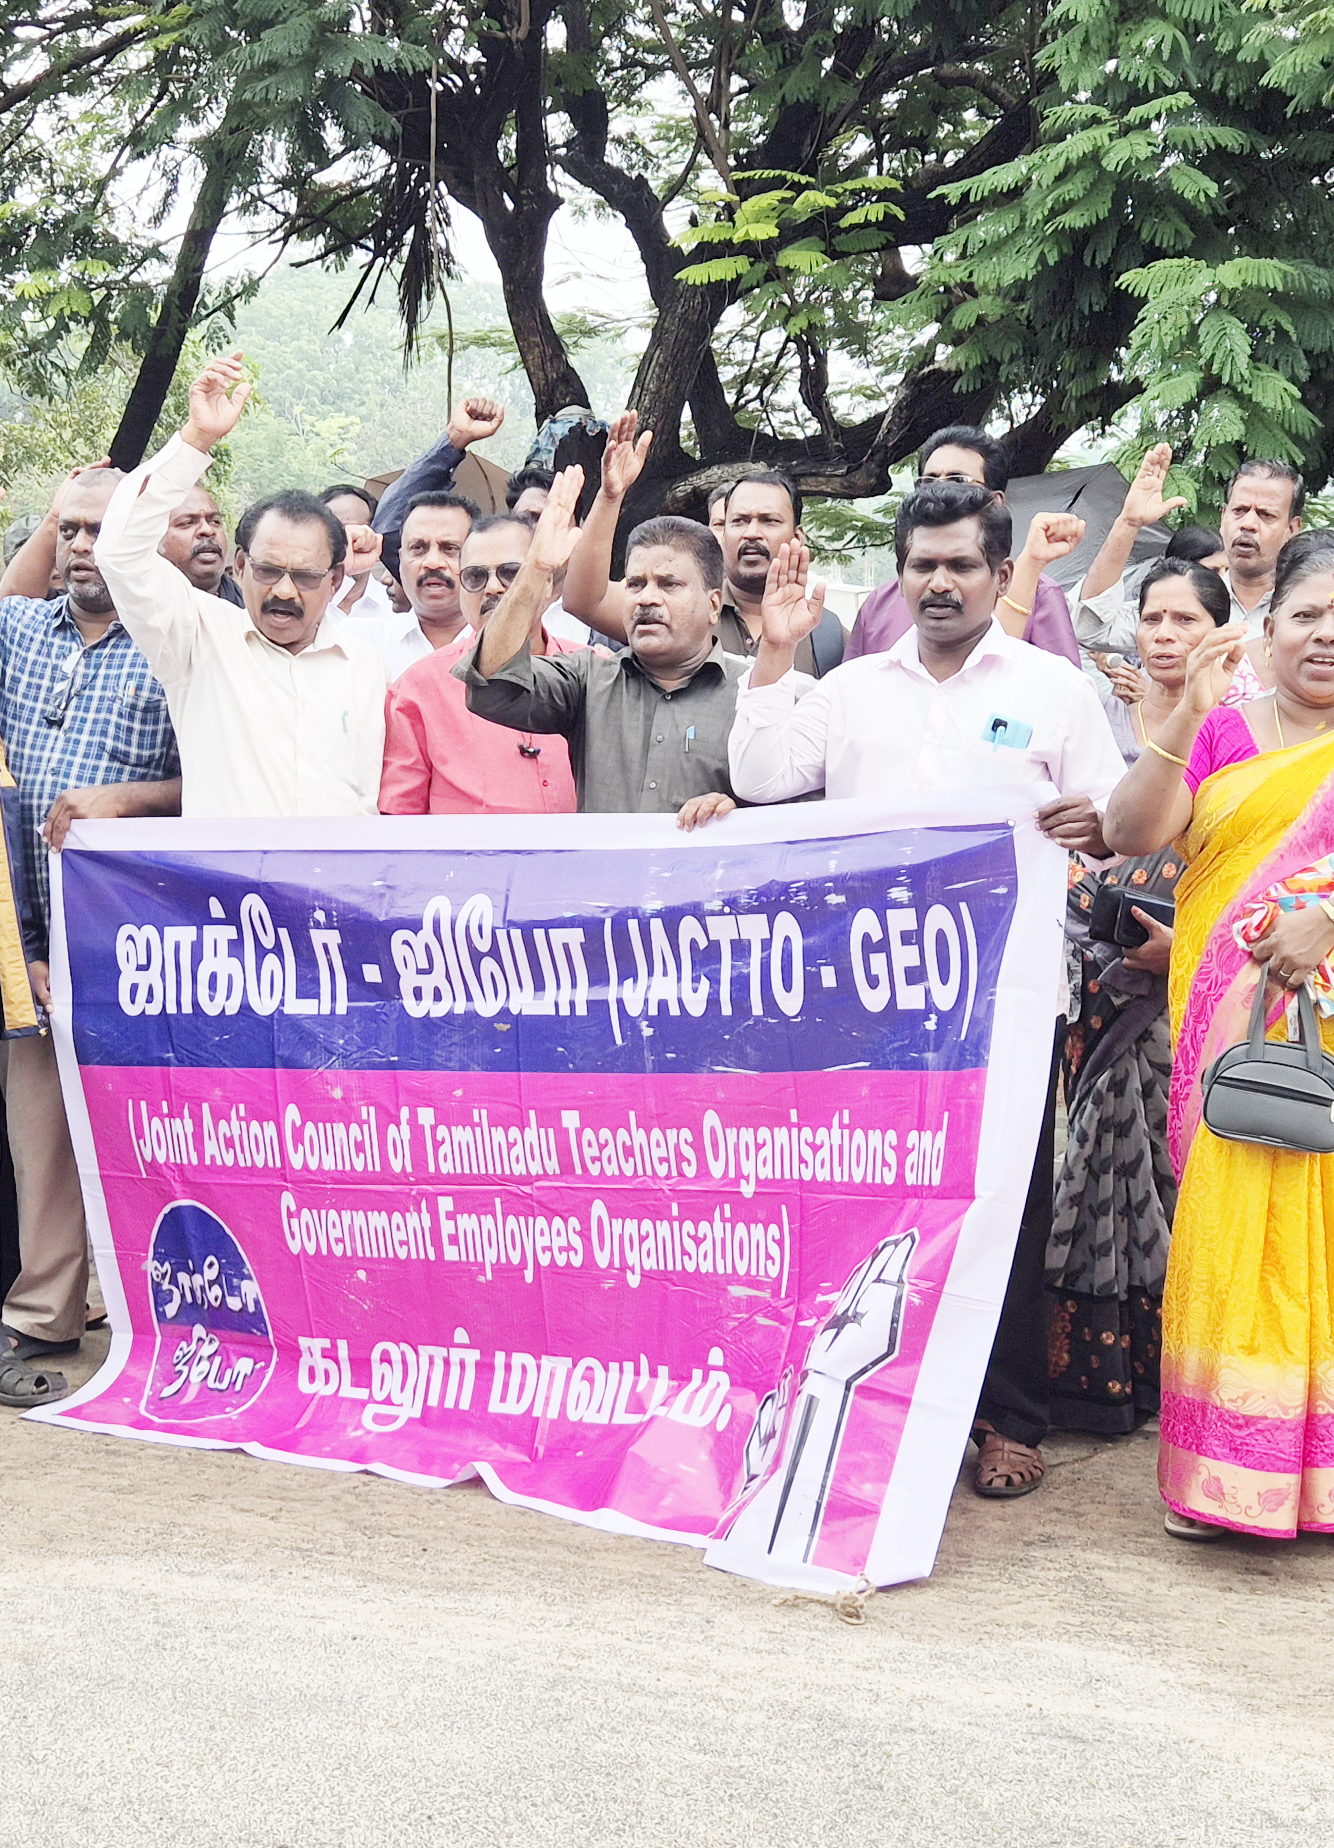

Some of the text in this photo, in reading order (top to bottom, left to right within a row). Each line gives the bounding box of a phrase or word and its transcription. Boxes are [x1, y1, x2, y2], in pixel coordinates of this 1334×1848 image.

[116, 892, 348, 1017] ஜாக்டோ
[390, 892, 589, 1019] ஜியோ
[603, 910, 805, 1046] (JACTTO
[849, 901, 978, 1042] GEO)
[128, 1098, 950, 1199] (Joint Action Council of Tamilnadu Teachers Organisations and
[280, 1190, 791, 1299] Government Employees Organisations)
[296, 1326, 481, 1433] கடலூர்
